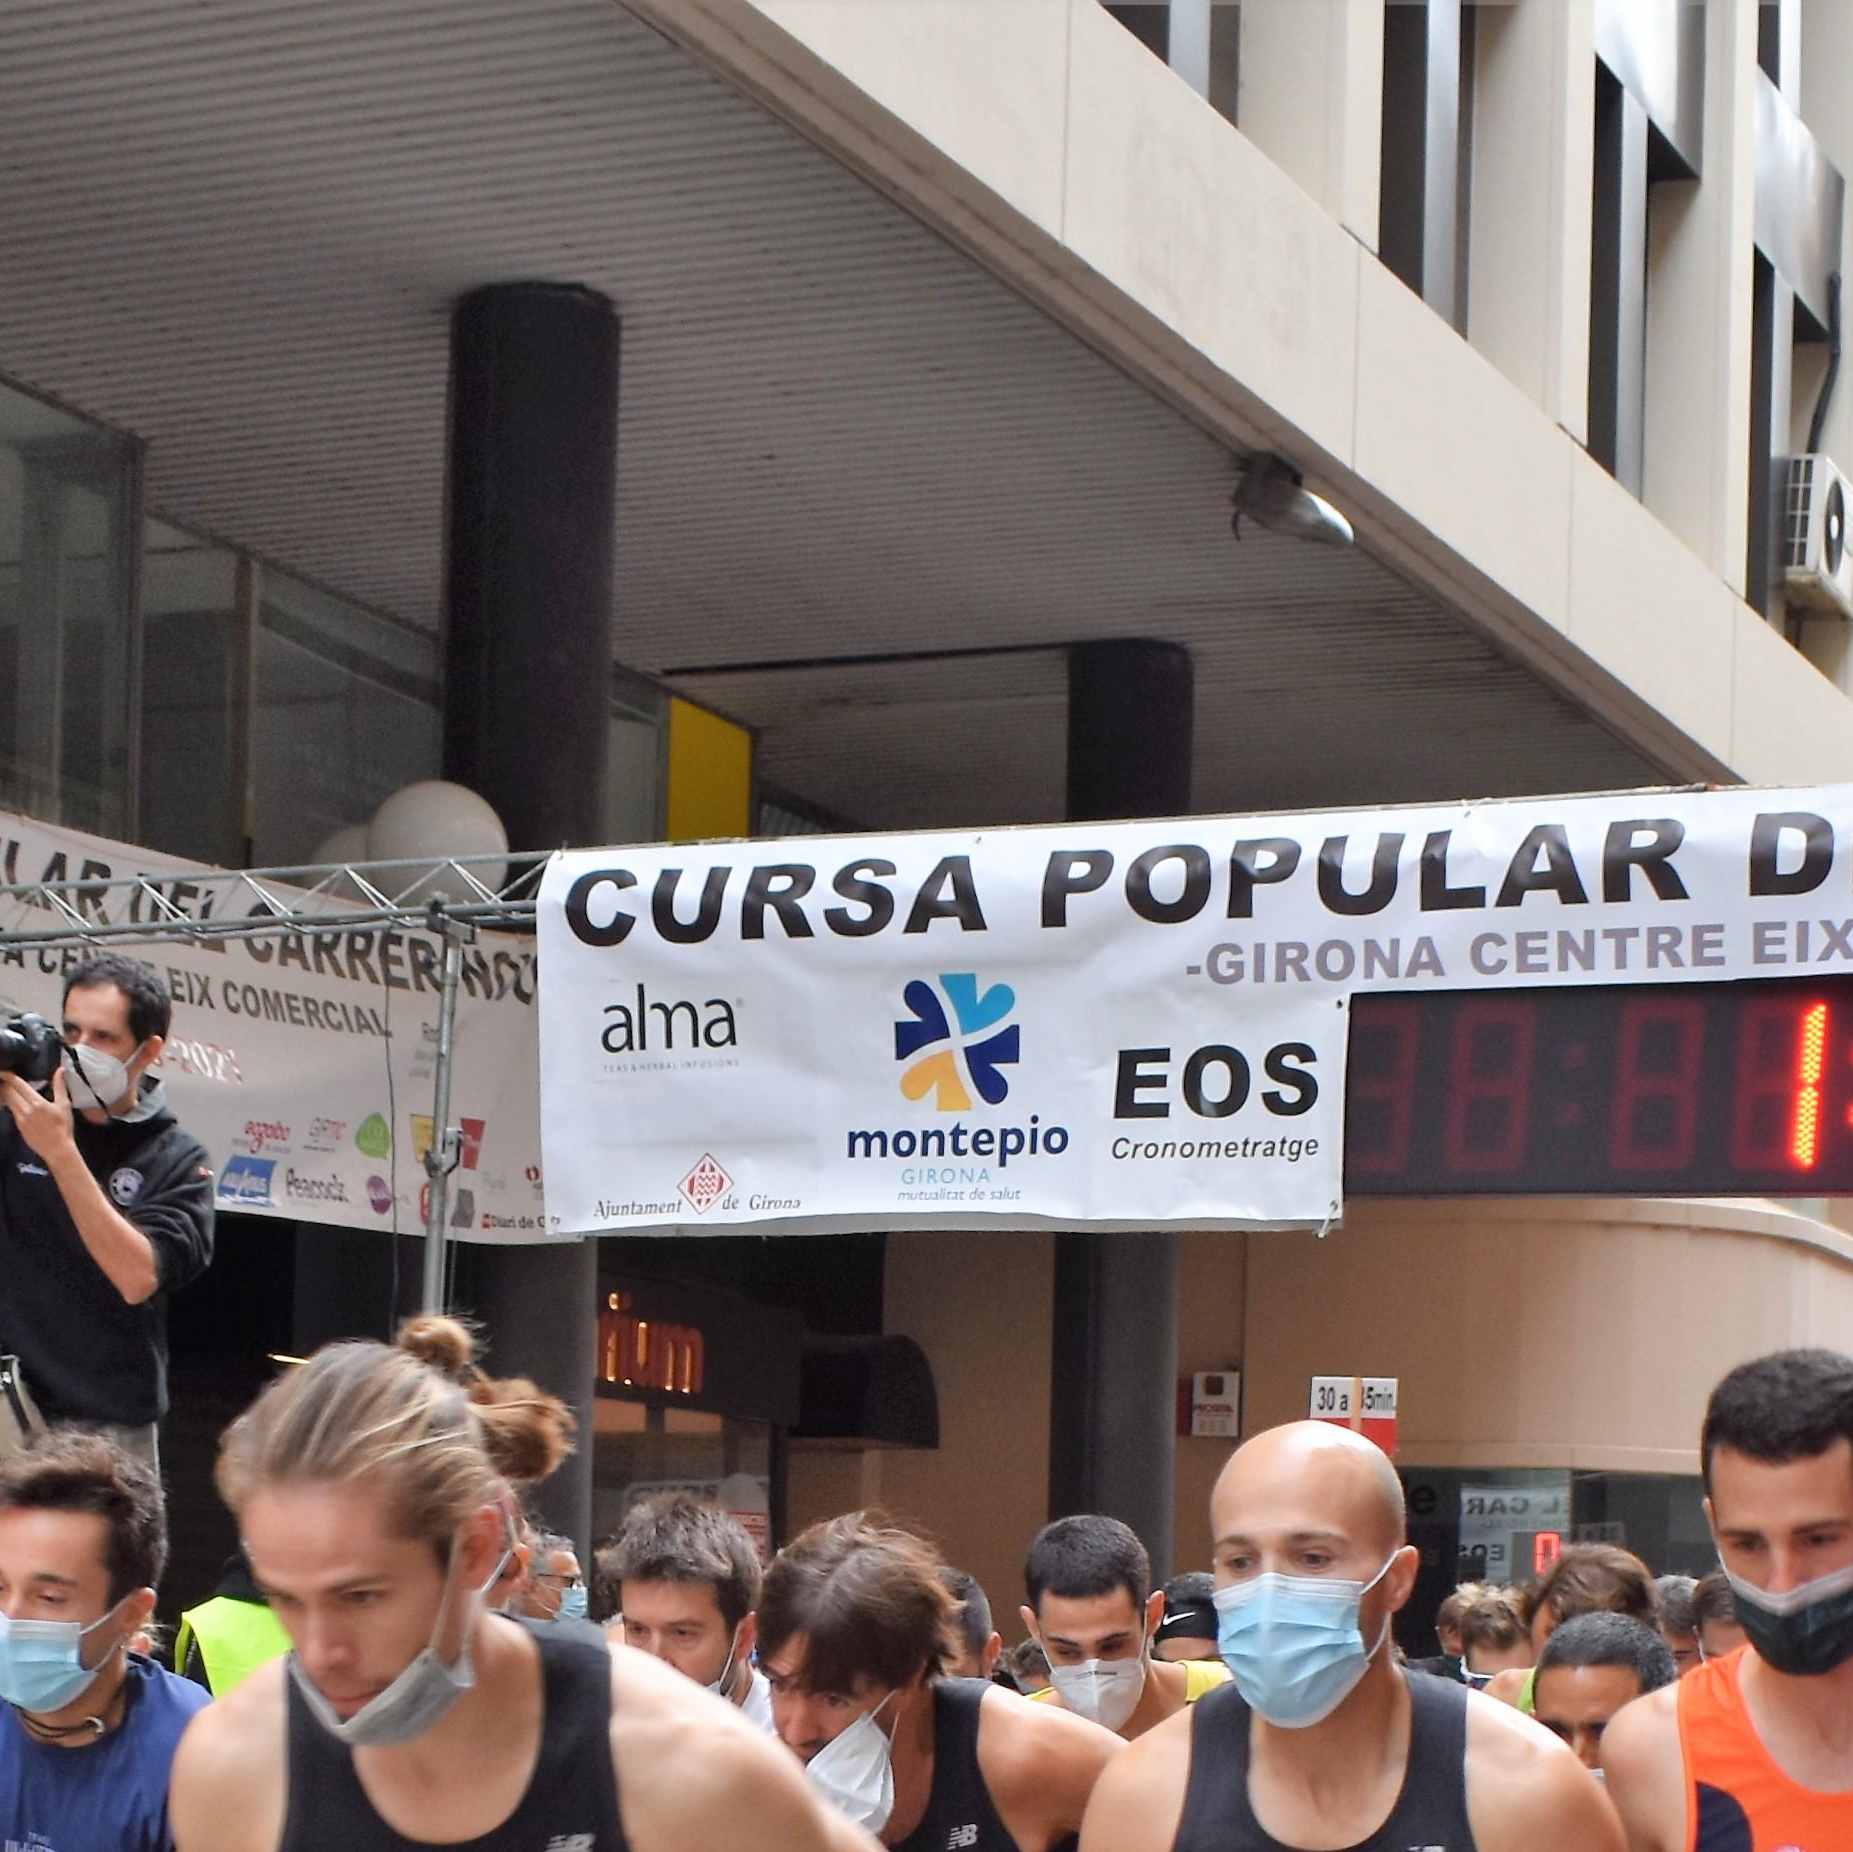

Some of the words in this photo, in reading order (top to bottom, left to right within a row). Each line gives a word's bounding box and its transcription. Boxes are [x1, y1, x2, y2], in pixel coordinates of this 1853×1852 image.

[563, 854, 989, 949] CURSA
[1038, 815, 1693, 932] POPULAR
[1185, 936, 1447, 986] -GIRONA
[1468, 922, 1727, 977] CENTRE
[166, 963, 217, 1010] EIX
[223, 979, 394, 1038] COMERCIAL
[600, 982, 739, 1054] alma
[1112, 1041, 1320, 1121] EOS
[846, 1114, 1070, 1168] montepio
[1110, 1133, 1320, 1165] Cronometratge
[896, 1185, 964, 1202] mutualitat
[968, 1185, 984, 1201] de
[988, 1185, 1023, 1202] salut
[900, 1167, 993, 1187] GIRONA
[593, 1199, 683, 1221] Ajuntament
[721, 1196, 739, 1212] de
[748, 1193, 802, 1212] Girona
[1316, 1386, 1336, 1412] 30
[1339, 1393, 1348, 1412] a
[1360, 1386, 1394, 1411] 5min
